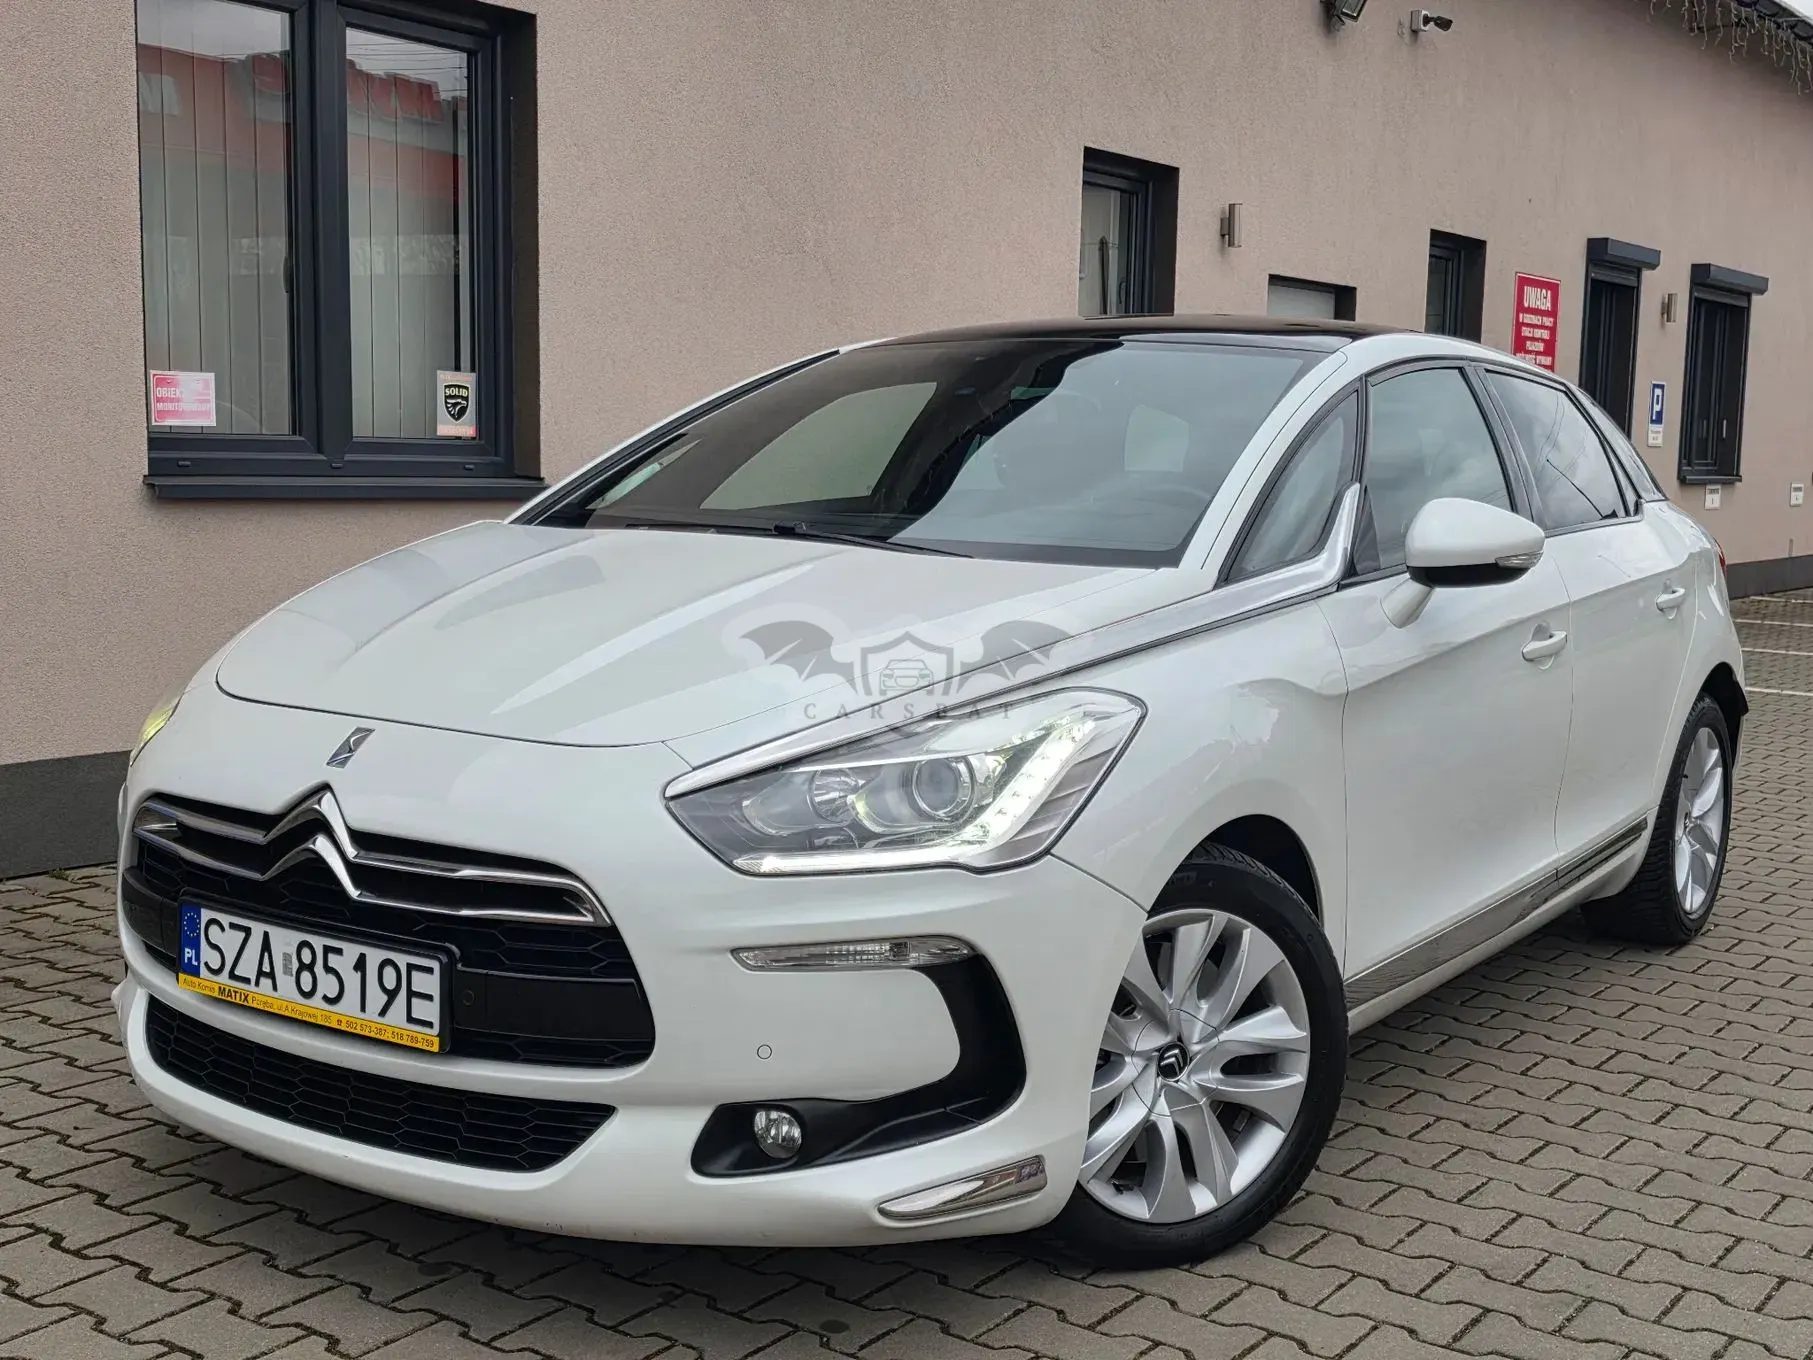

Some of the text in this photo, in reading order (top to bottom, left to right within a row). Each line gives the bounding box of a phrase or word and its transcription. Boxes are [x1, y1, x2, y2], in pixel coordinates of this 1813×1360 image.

[1523, 285, 1551, 310] UWAGA
[445, 387, 468, 397] SOLID
[1652, 388, 1662, 420] P
[184, 948, 198, 966] PL
[204, 917, 435, 1029] SZA 8519E
[183, 978, 197, 988] Auto
[218, 986, 249, 1004] MATIX
[345, 1020, 358, 1031] 502
[391, 1031, 404, 1041] 518
[406, 1034, 434, 1048] 789-759
